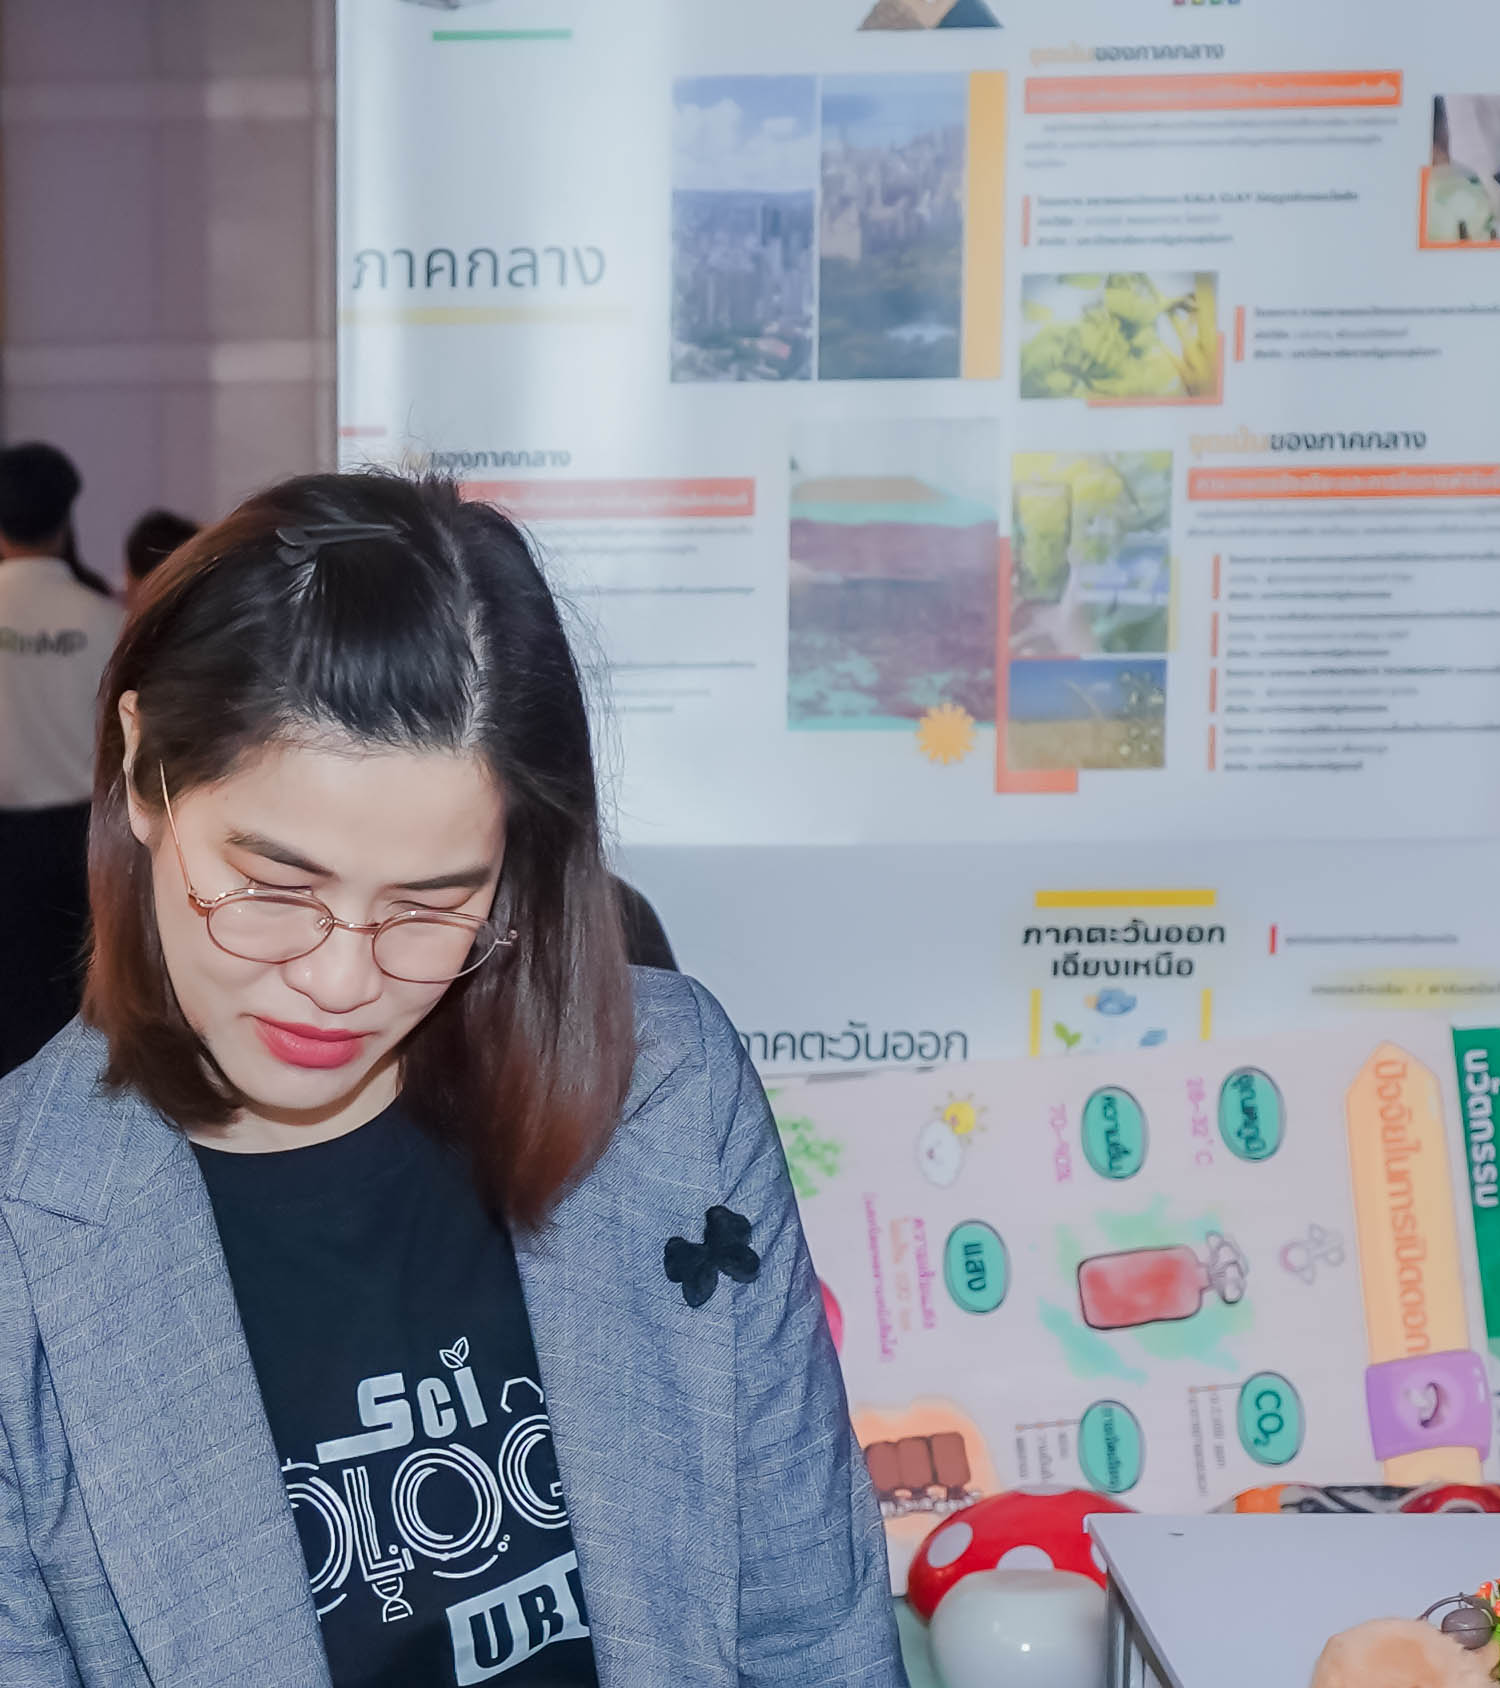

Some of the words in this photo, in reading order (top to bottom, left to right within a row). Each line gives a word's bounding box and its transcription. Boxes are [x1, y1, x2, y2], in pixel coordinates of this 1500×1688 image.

[352, 243, 606, 291] ภาคกลาง
[1022, 919, 1226, 946] ภาคตะวันออก
[1051, 951, 1195, 979] เฉียงเหนือ
[962, 1242, 989, 1293] แสง
[316, 1355, 488, 1464] Sci
